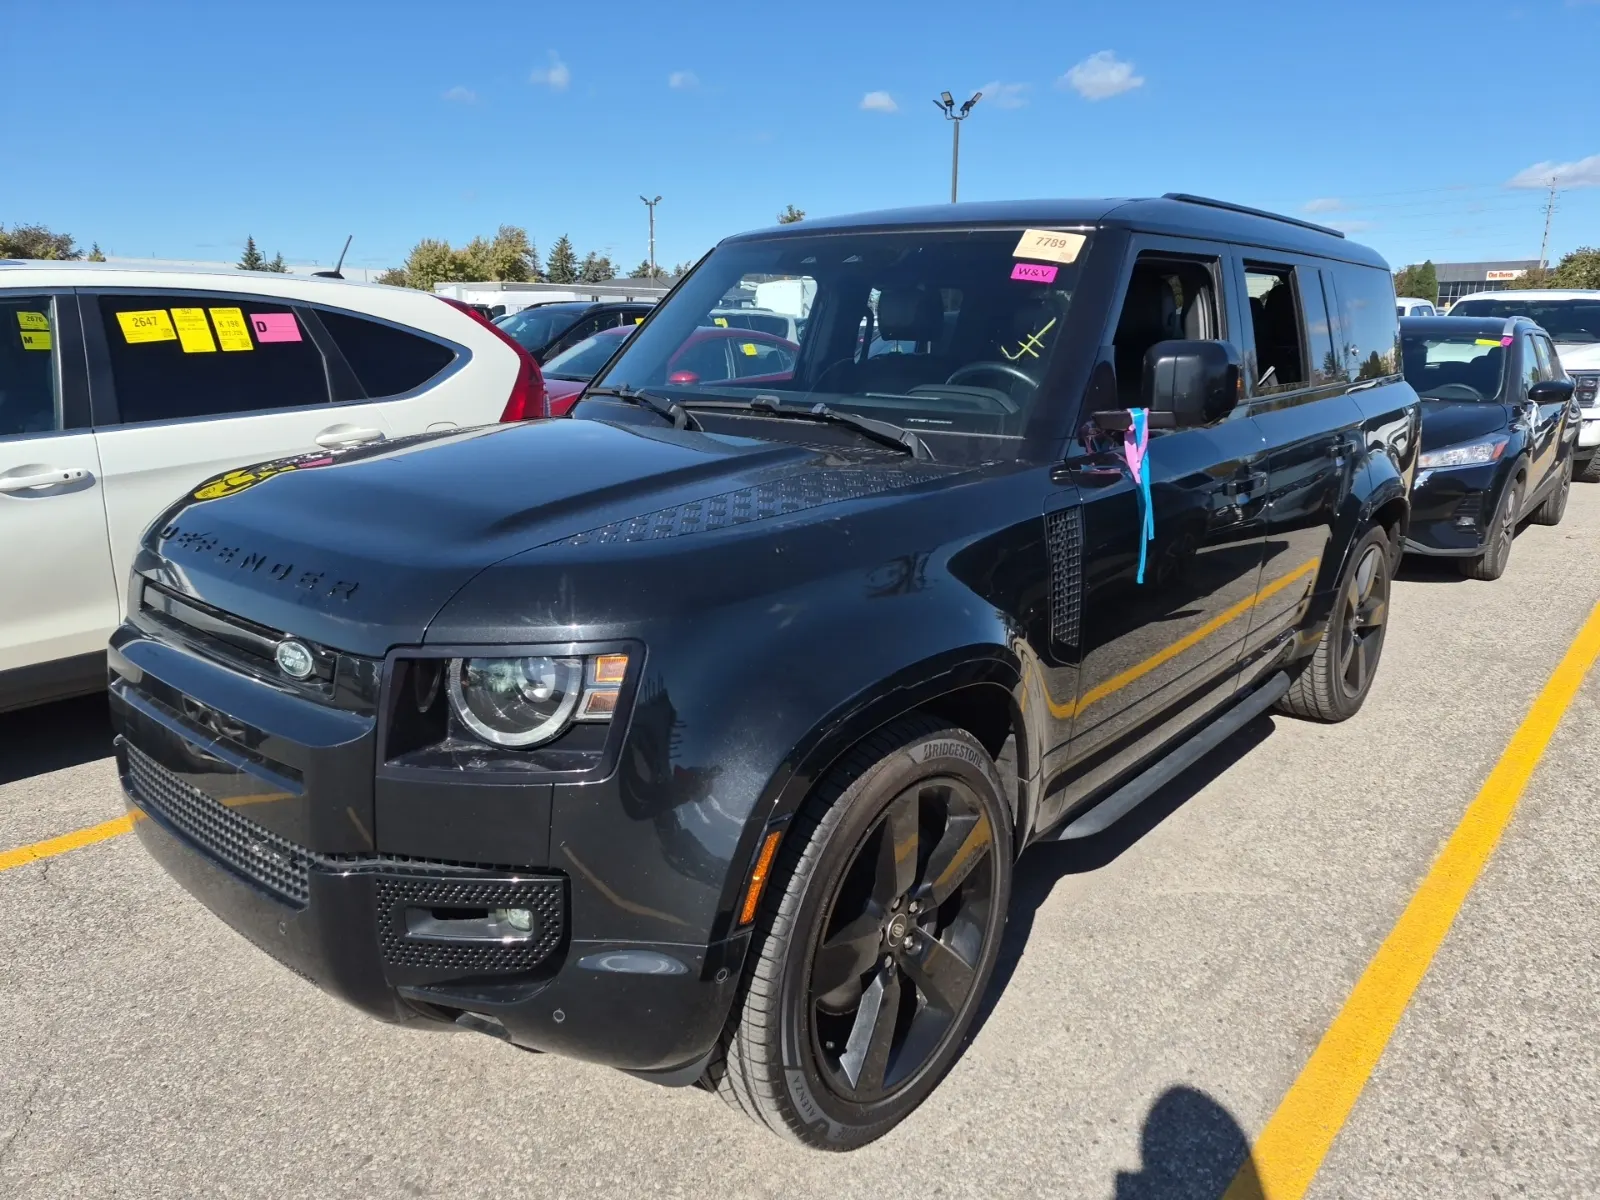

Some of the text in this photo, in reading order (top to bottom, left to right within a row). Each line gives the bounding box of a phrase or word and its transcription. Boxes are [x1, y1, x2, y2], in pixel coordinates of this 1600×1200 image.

[1035, 236, 1067, 249] 7789
[1018, 267, 1051, 277] W&V
[132, 316, 158, 328] 2647
[255, 321, 267, 333] D
[23, 336, 33, 344] M
[923, 743, 983, 768] BRIDGESTONE
[793, 1075, 817, 1118] ALENZA
